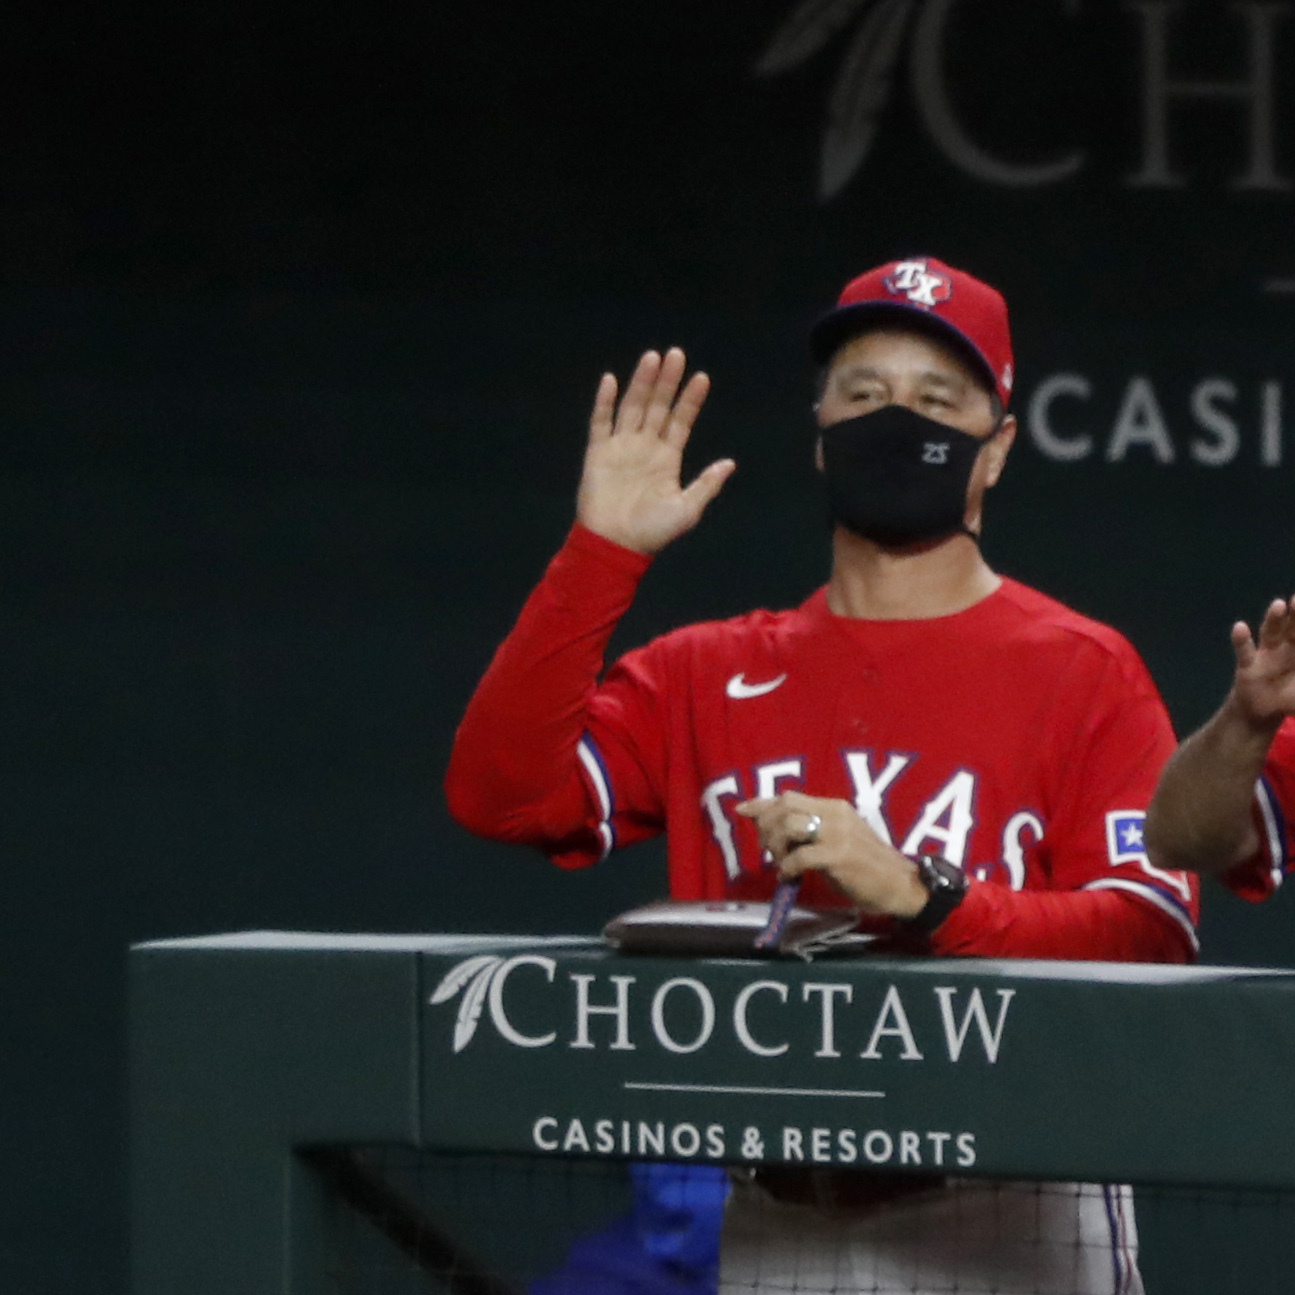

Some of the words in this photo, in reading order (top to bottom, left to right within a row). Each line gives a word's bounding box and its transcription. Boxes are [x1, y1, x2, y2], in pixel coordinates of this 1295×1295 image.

[488, 953, 1017, 1065] CHOCTAW
[531, 1116, 726, 1159] CASINOS
[741, 1124, 766, 1161] &
[782, 1126, 978, 1168] RESORTS
